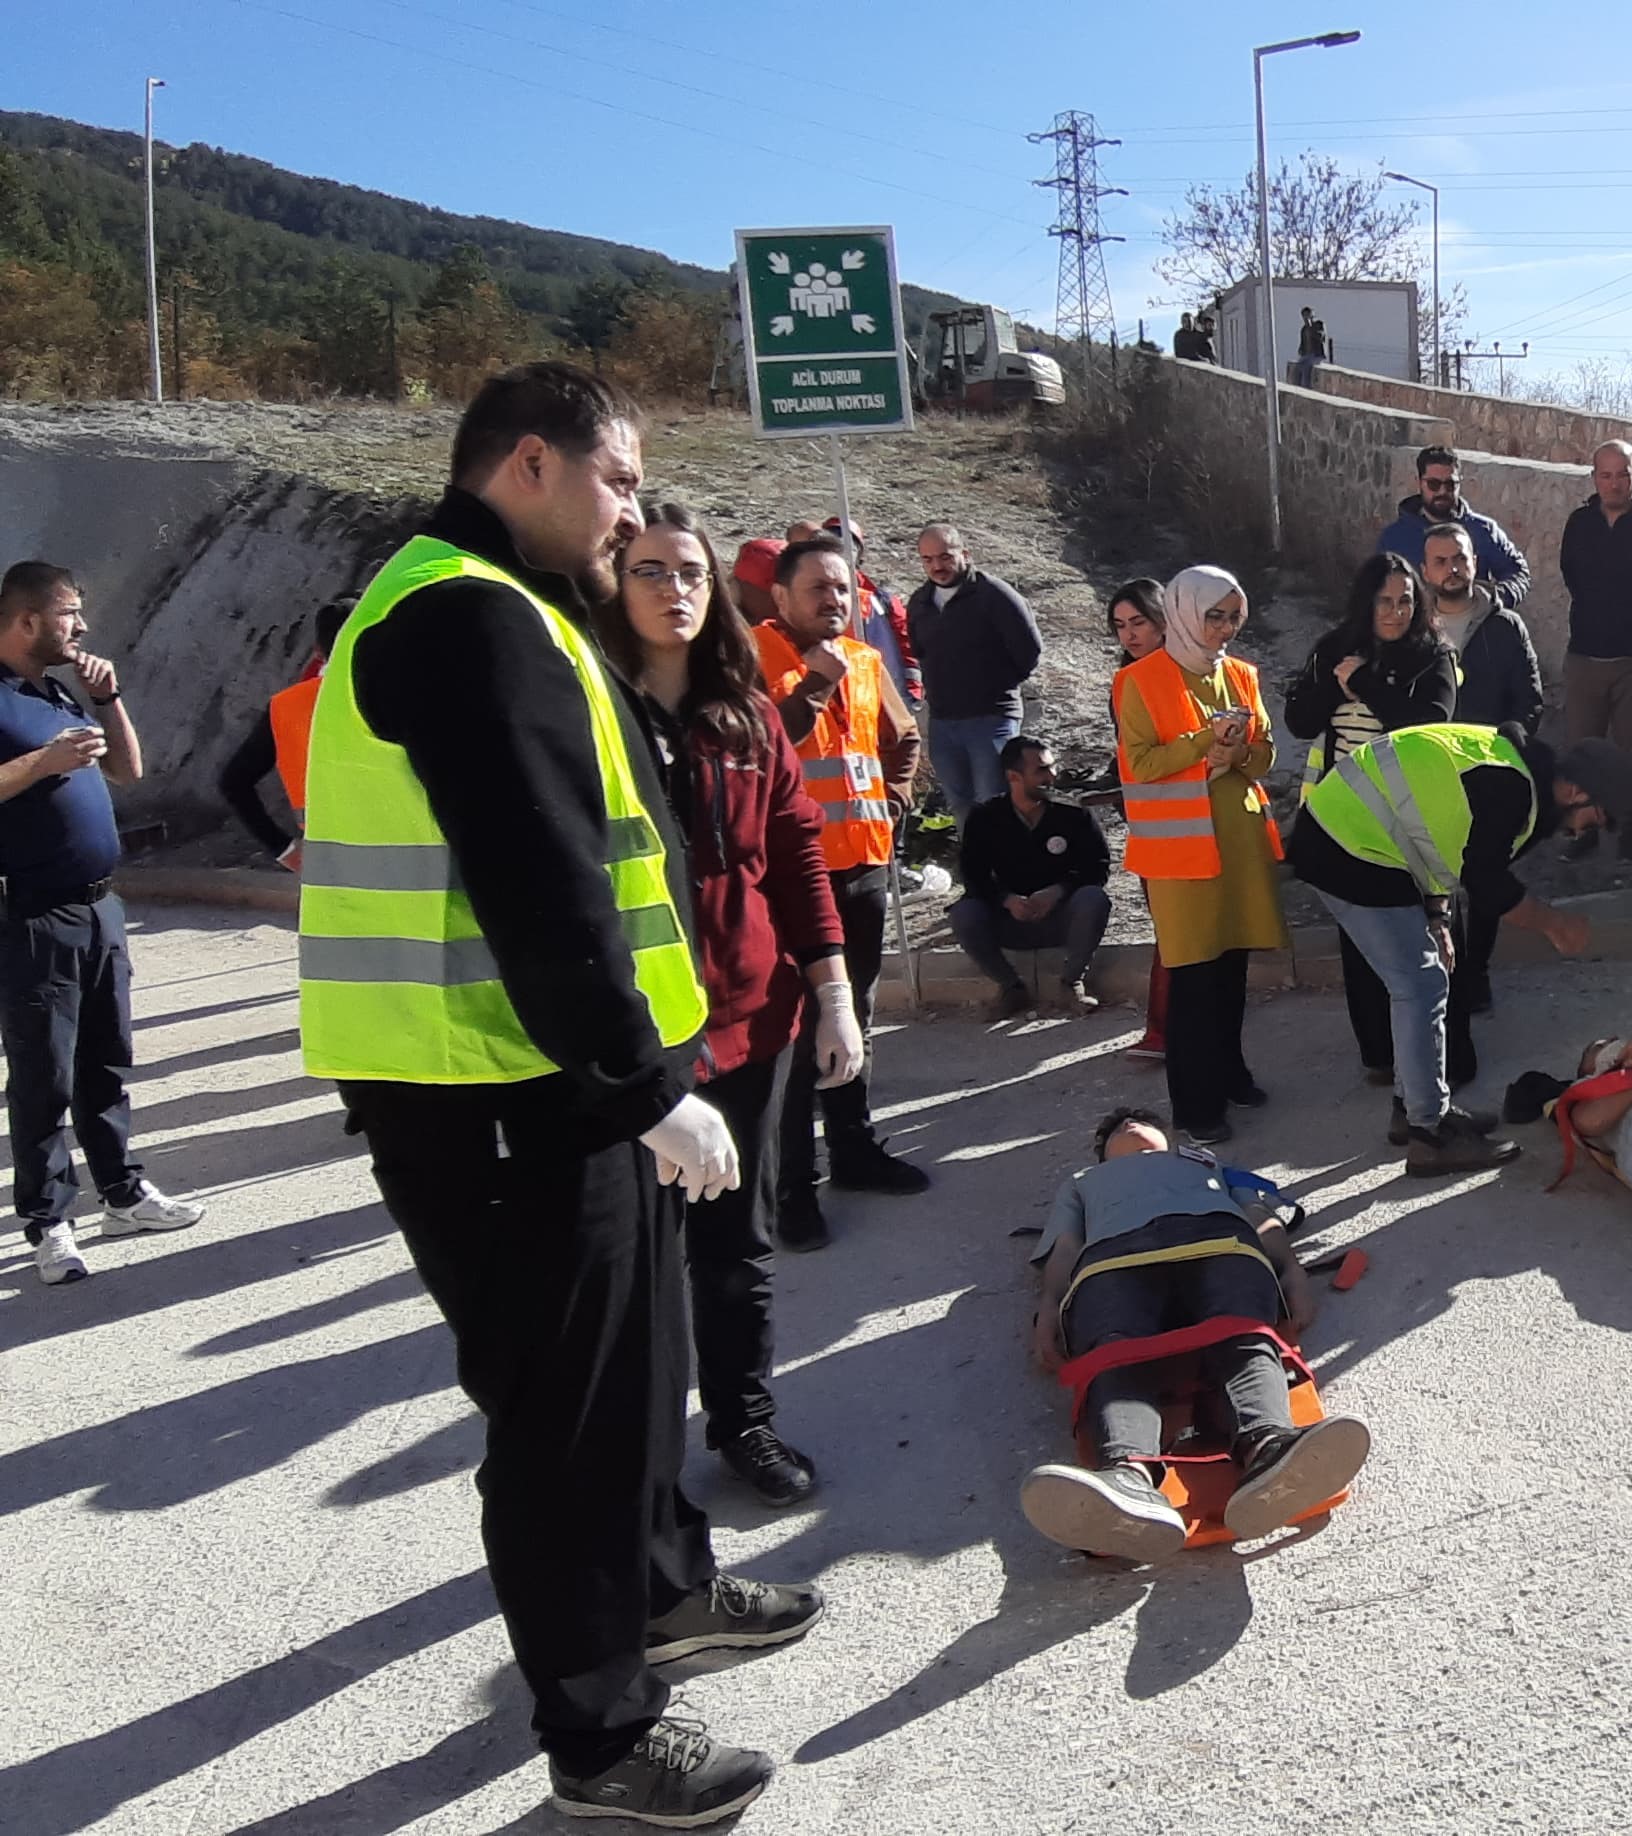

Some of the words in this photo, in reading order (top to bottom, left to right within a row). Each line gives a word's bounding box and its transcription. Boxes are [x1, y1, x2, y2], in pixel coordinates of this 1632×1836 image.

[792, 369, 818, 386] ACİL
[820, 369, 861, 386] DURUM
[772, 396, 834, 414] TOPLANMA
[836, 394, 885, 410] NOKTASI
